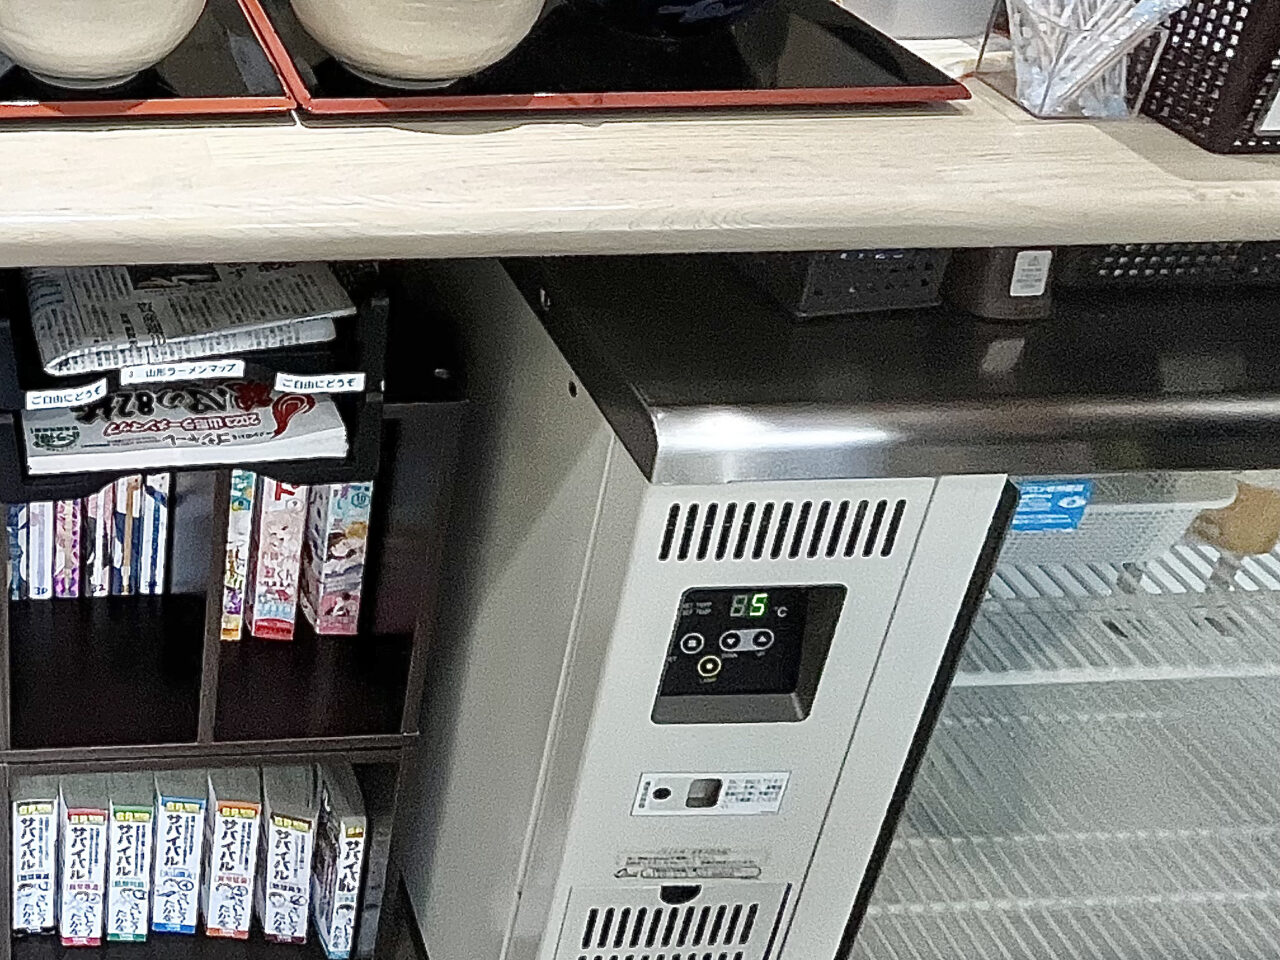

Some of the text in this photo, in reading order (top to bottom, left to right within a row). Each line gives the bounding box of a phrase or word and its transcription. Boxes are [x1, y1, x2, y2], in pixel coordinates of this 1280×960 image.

[31, 385, 103, 406] ご自由にどうぞ
[146, 363, 237, 378] 山形ラーメンマップ
[282, 377, 357, 390] ご自由にどうぞ
[749, 593, 788, 618] 5 °C
[20, 817, 37, 871] サバイバル
[71, 827, 87, 879] サバイバル
[116, 824, 133, 876] サバイバル
[164, 815, 182, 866] サバイバル
[219, 819, 239, 871] サバイバル
[274, 829, 292, 880] サバイバル
[338, 840, 361, 892] サバイバル
